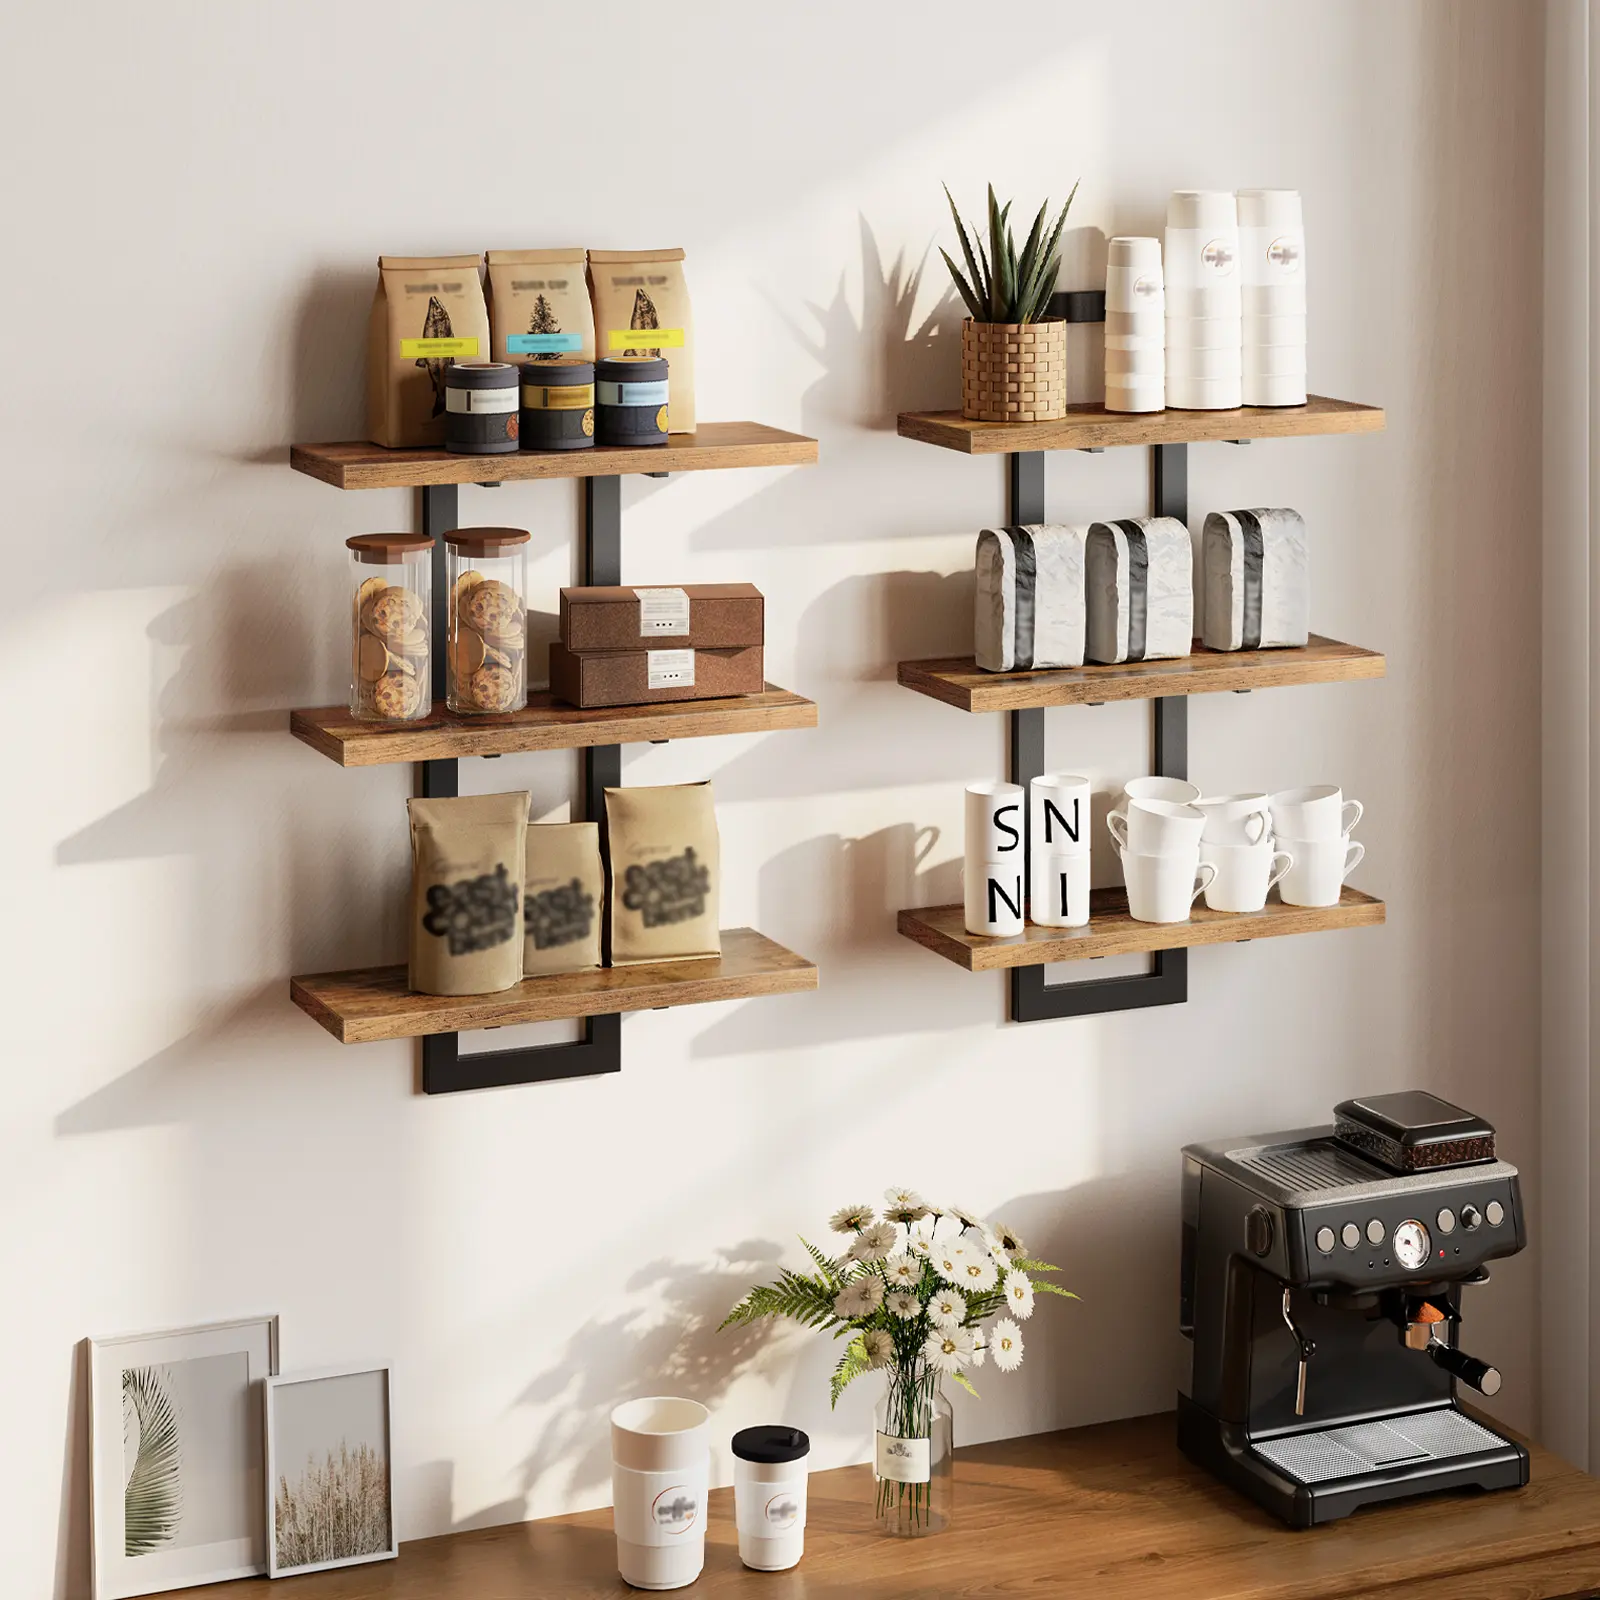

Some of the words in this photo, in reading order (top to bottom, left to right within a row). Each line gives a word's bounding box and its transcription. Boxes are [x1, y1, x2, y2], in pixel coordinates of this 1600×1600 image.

[993, 805, 1019, 851] S
[1044, 798, 1078, 843] N
[988, 875, 1021, 922] N
